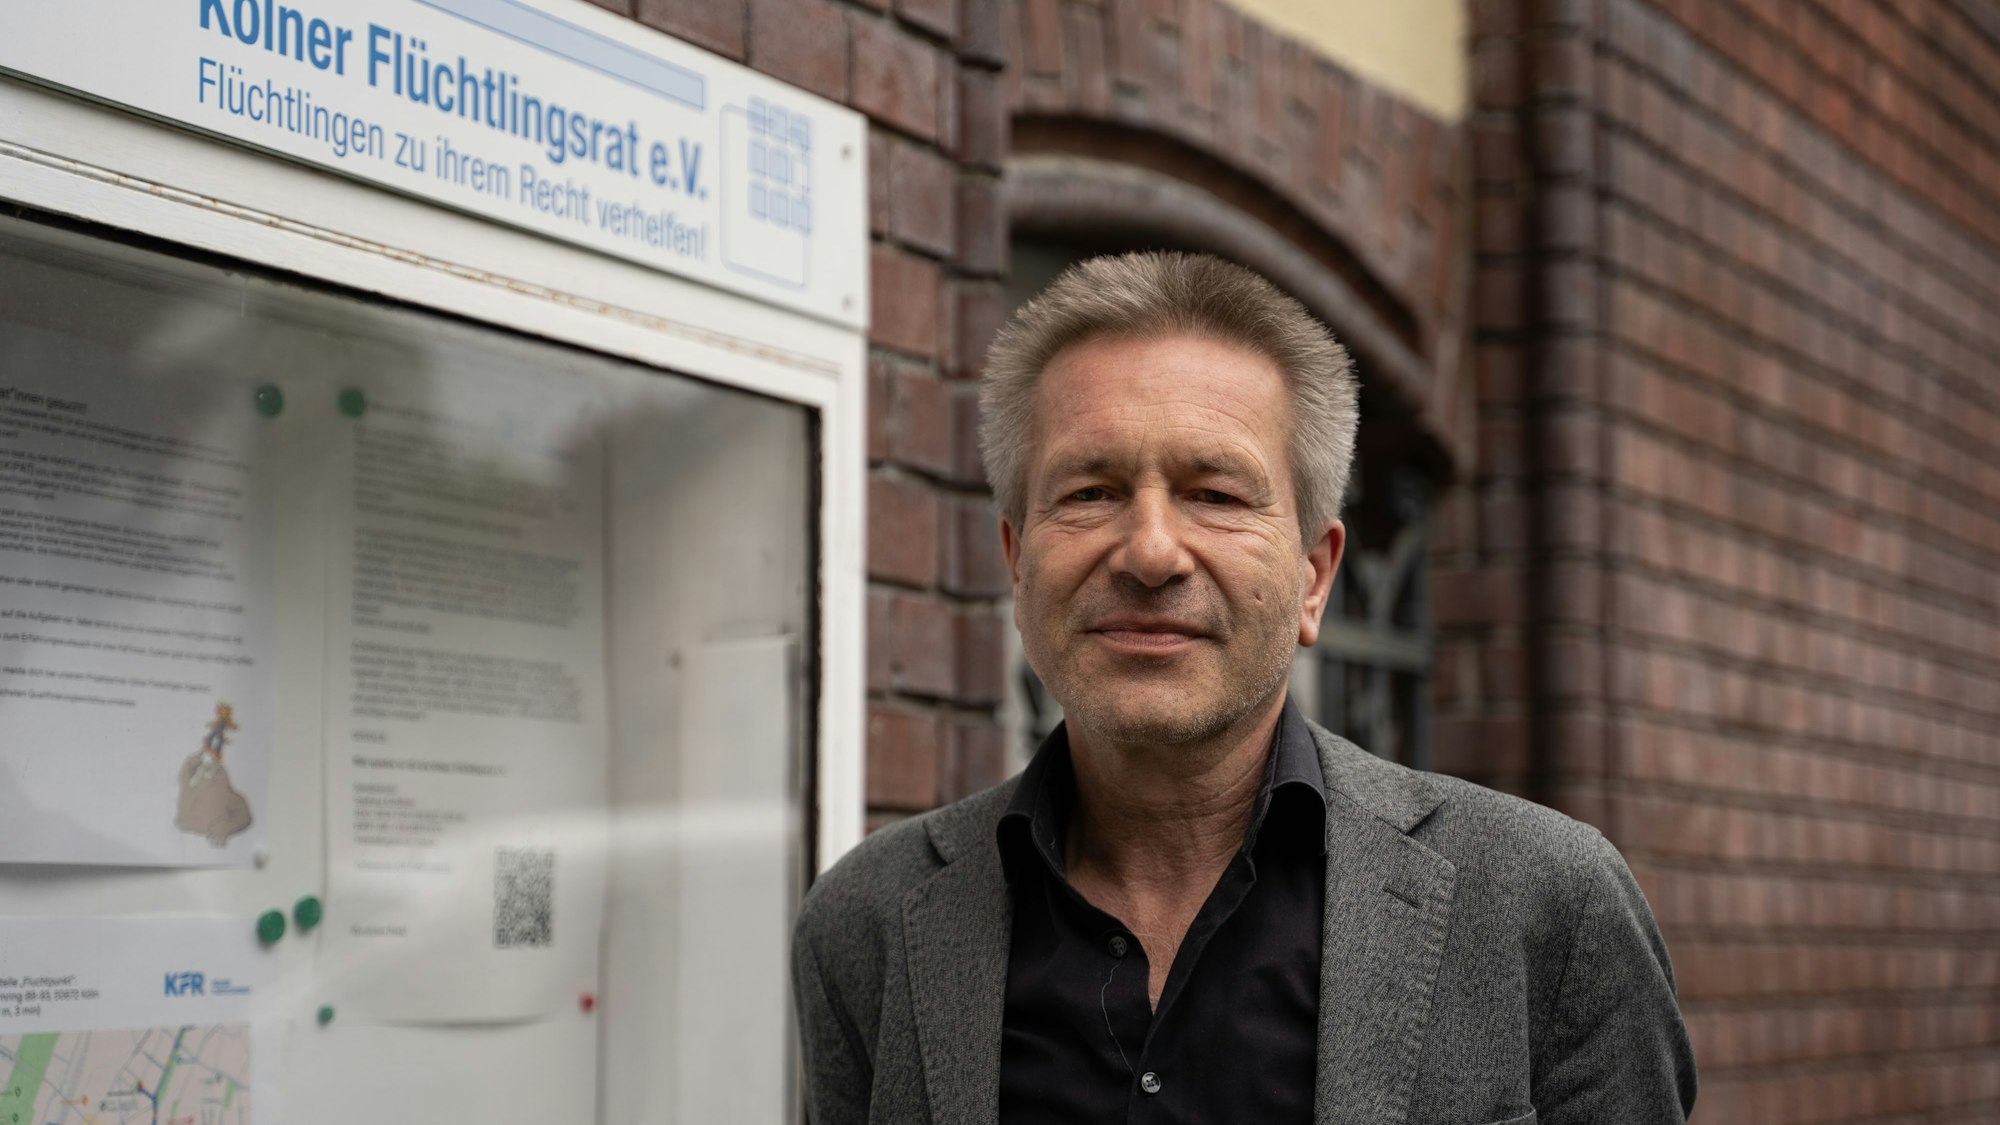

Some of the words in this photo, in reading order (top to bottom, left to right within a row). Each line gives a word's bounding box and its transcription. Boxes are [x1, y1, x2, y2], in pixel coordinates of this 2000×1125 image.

[199, 56, 384, 160] Flüchtlingen
[394, 132, 425, 173] zu
[435, 137, 511, 200] ihrem
[520, 163, 592, 226] Recht
[596, 198, 706, 260] verhelfen!
[368, 22, 640, 177] Flüchtlingsrat
[650, 138, 707, 199] e.V.
[163, 971, 205, 996] KFR
